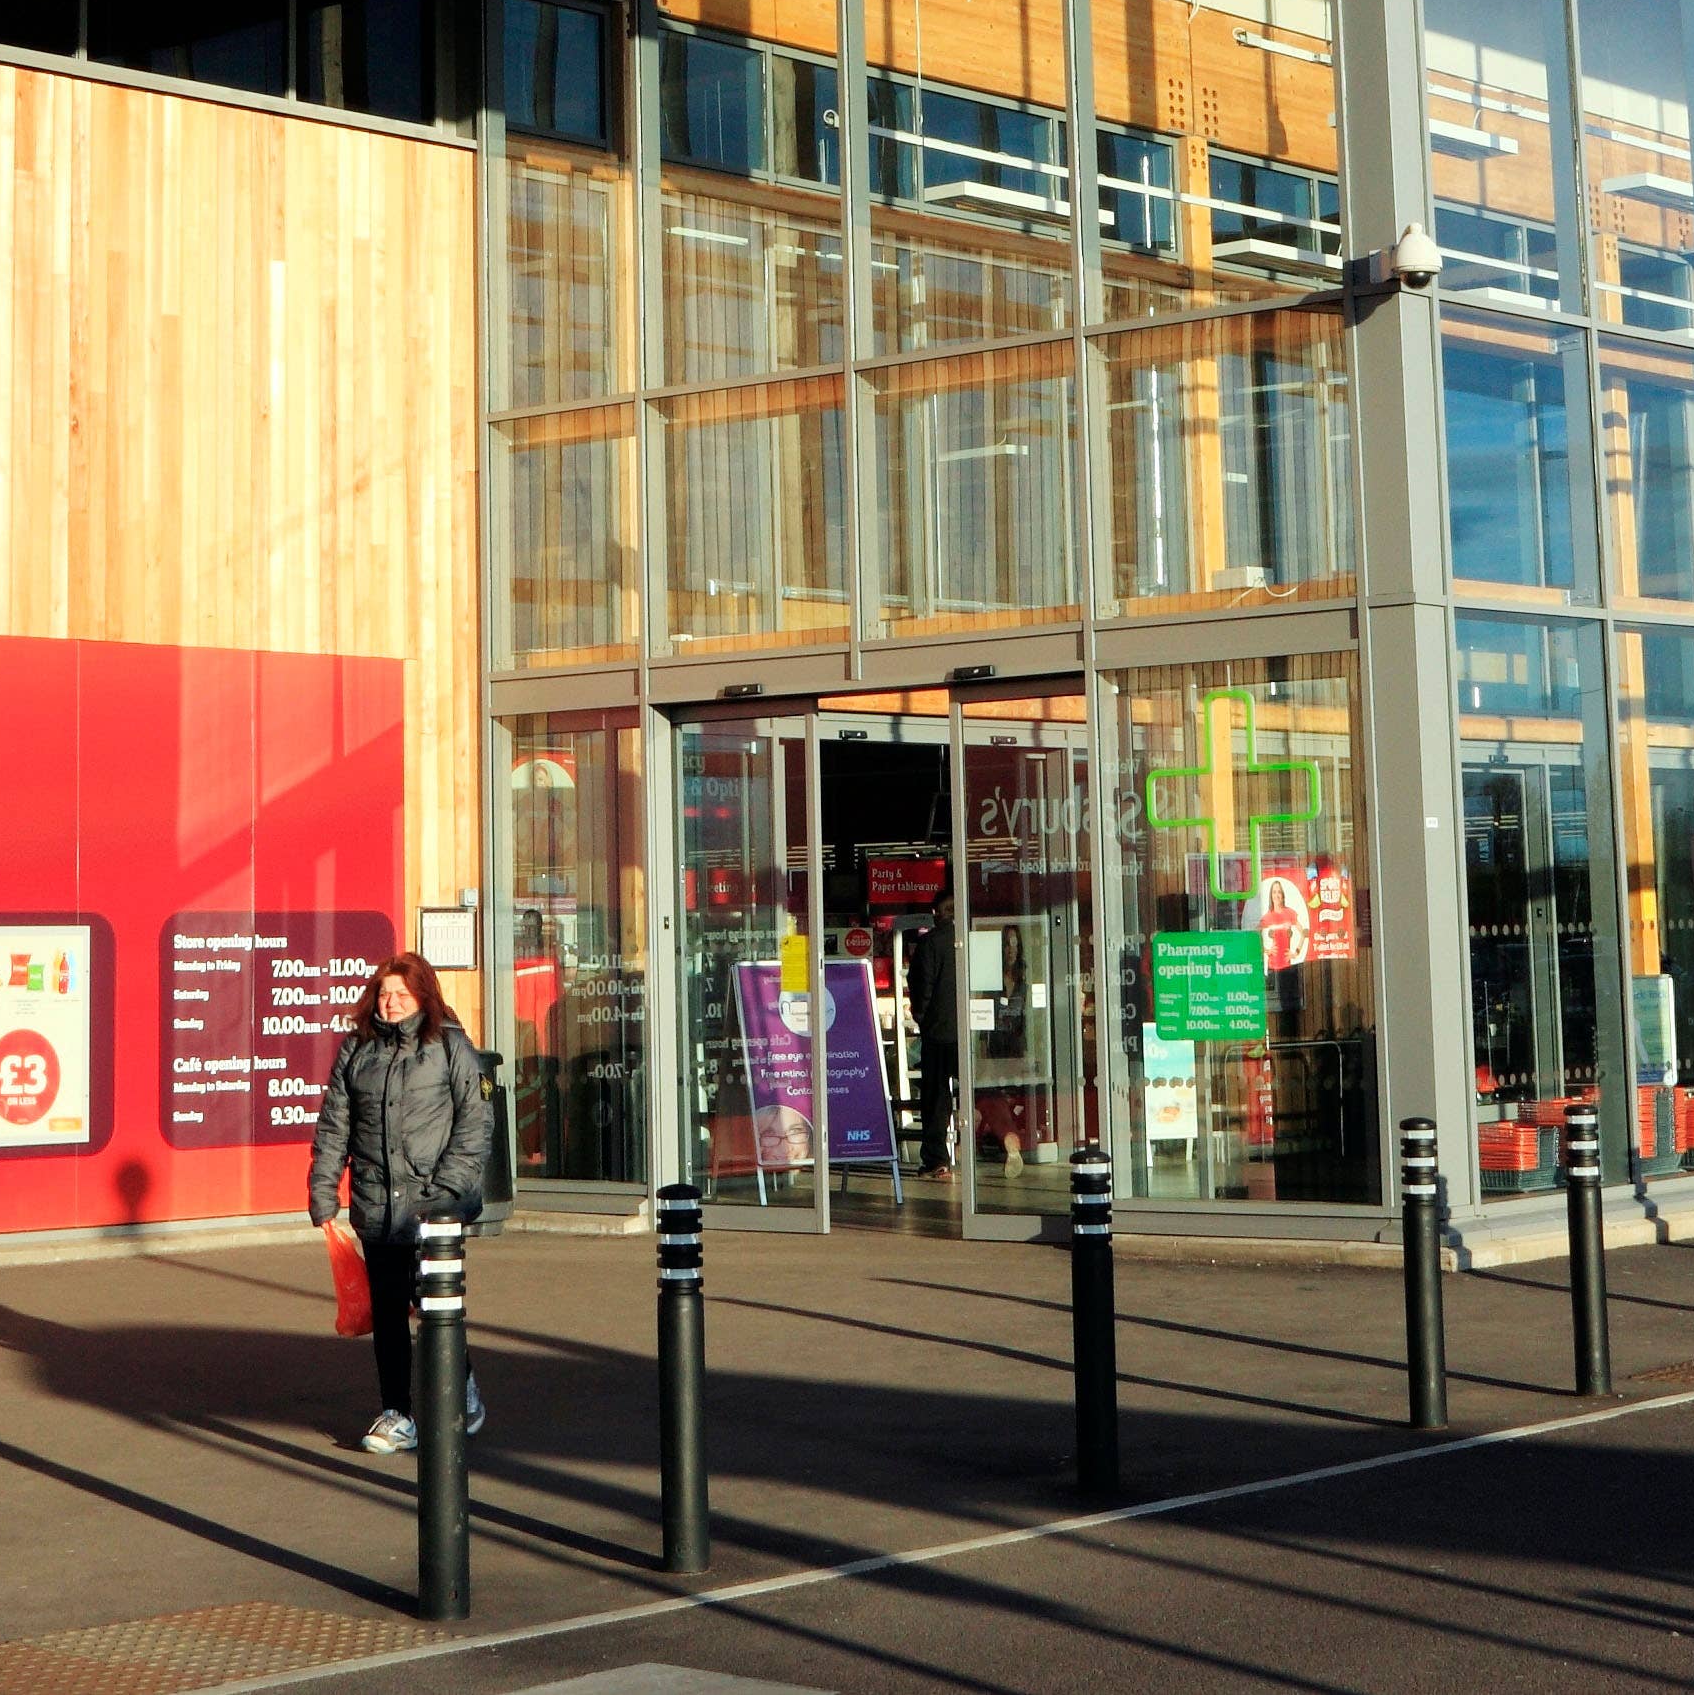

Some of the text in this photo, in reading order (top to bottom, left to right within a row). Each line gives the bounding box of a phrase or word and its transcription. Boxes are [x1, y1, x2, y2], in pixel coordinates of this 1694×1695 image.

[872, 868, 902, 880] Party &
[872, 881, 939, 894] Paper tableware
[174, 933, 287, 952] Store opening hours
[1157, 943, 1224, 959] Pharmacy
[174, 960, 206, 973] Monday
[207, 961, 215, 971] to
[216, 960, 241, 972] Friday
[271, 959, 321, 978] 7.00am
[1158, 961, 1253, 979] opening hours
[174, 989, 210, 1001] Saturday
[271, 987, 321, 1006] 7.00am
[174, 1018, 204, 1031] Sunday
[262, 1016, 321, 1035] 10.00am
[173, 1055, 287, 1074] Café opening hours
[788, 1053, 804, 1063] eye
[173, 1082, 206, 1094] Monday
[207, 1083, 215, 1092] to
[216, 1080, 251, 1092] Saturday
[268, 1077, 321, 1098] 8.00am
[173, 1111, 203, 1123] Sunday
[848, 1130, 871, 1141] NHS
